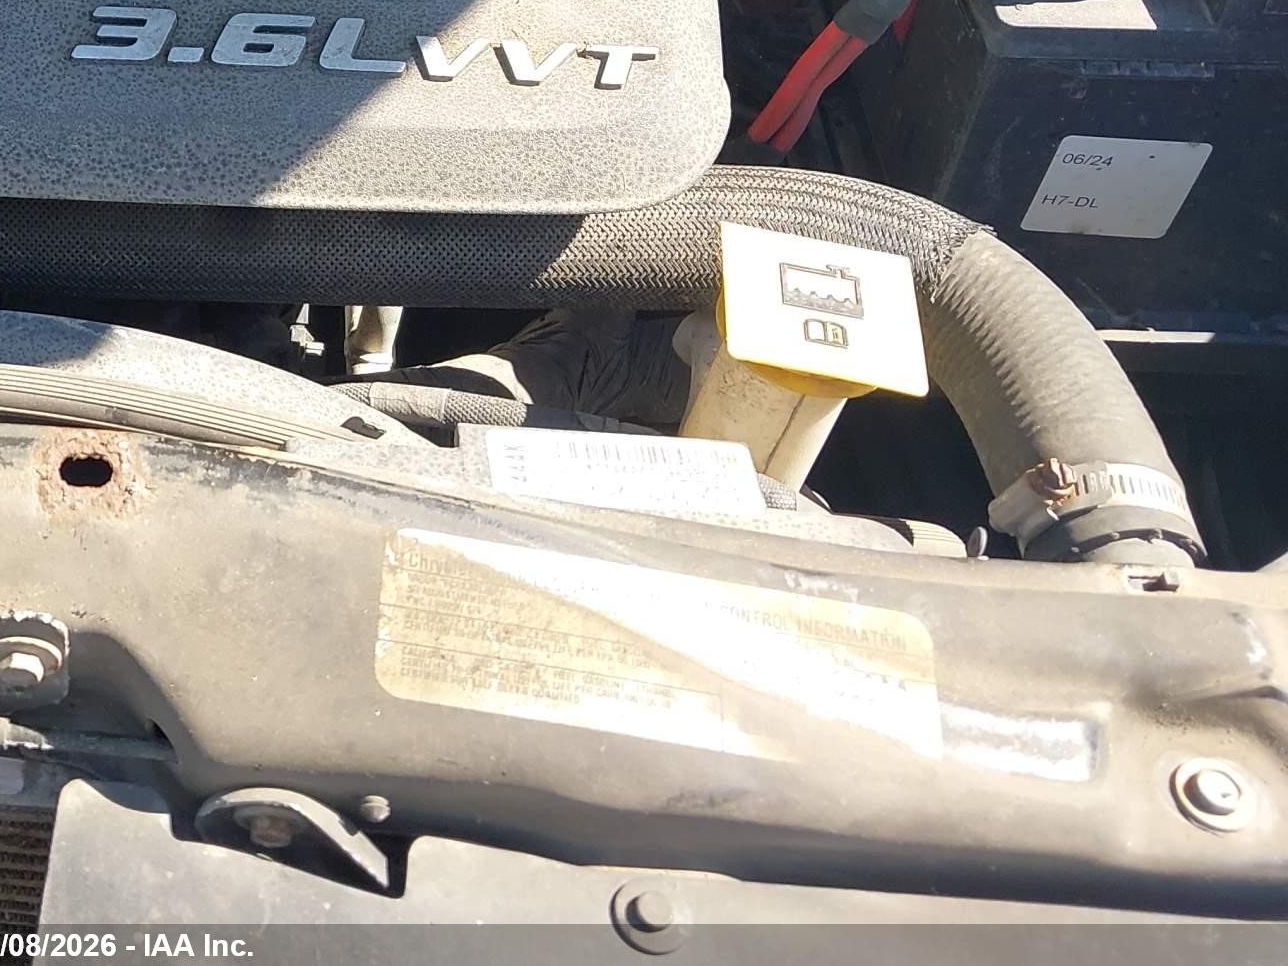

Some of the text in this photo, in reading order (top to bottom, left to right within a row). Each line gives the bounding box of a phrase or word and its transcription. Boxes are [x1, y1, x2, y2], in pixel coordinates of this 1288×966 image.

[1062, 153, 1113, 168] 06/24
[1041, 194, 1099, 209] H7-DL
[720, 604, 792, 631] CONTROL
[797, 618, 906, 651] INFORMATION
